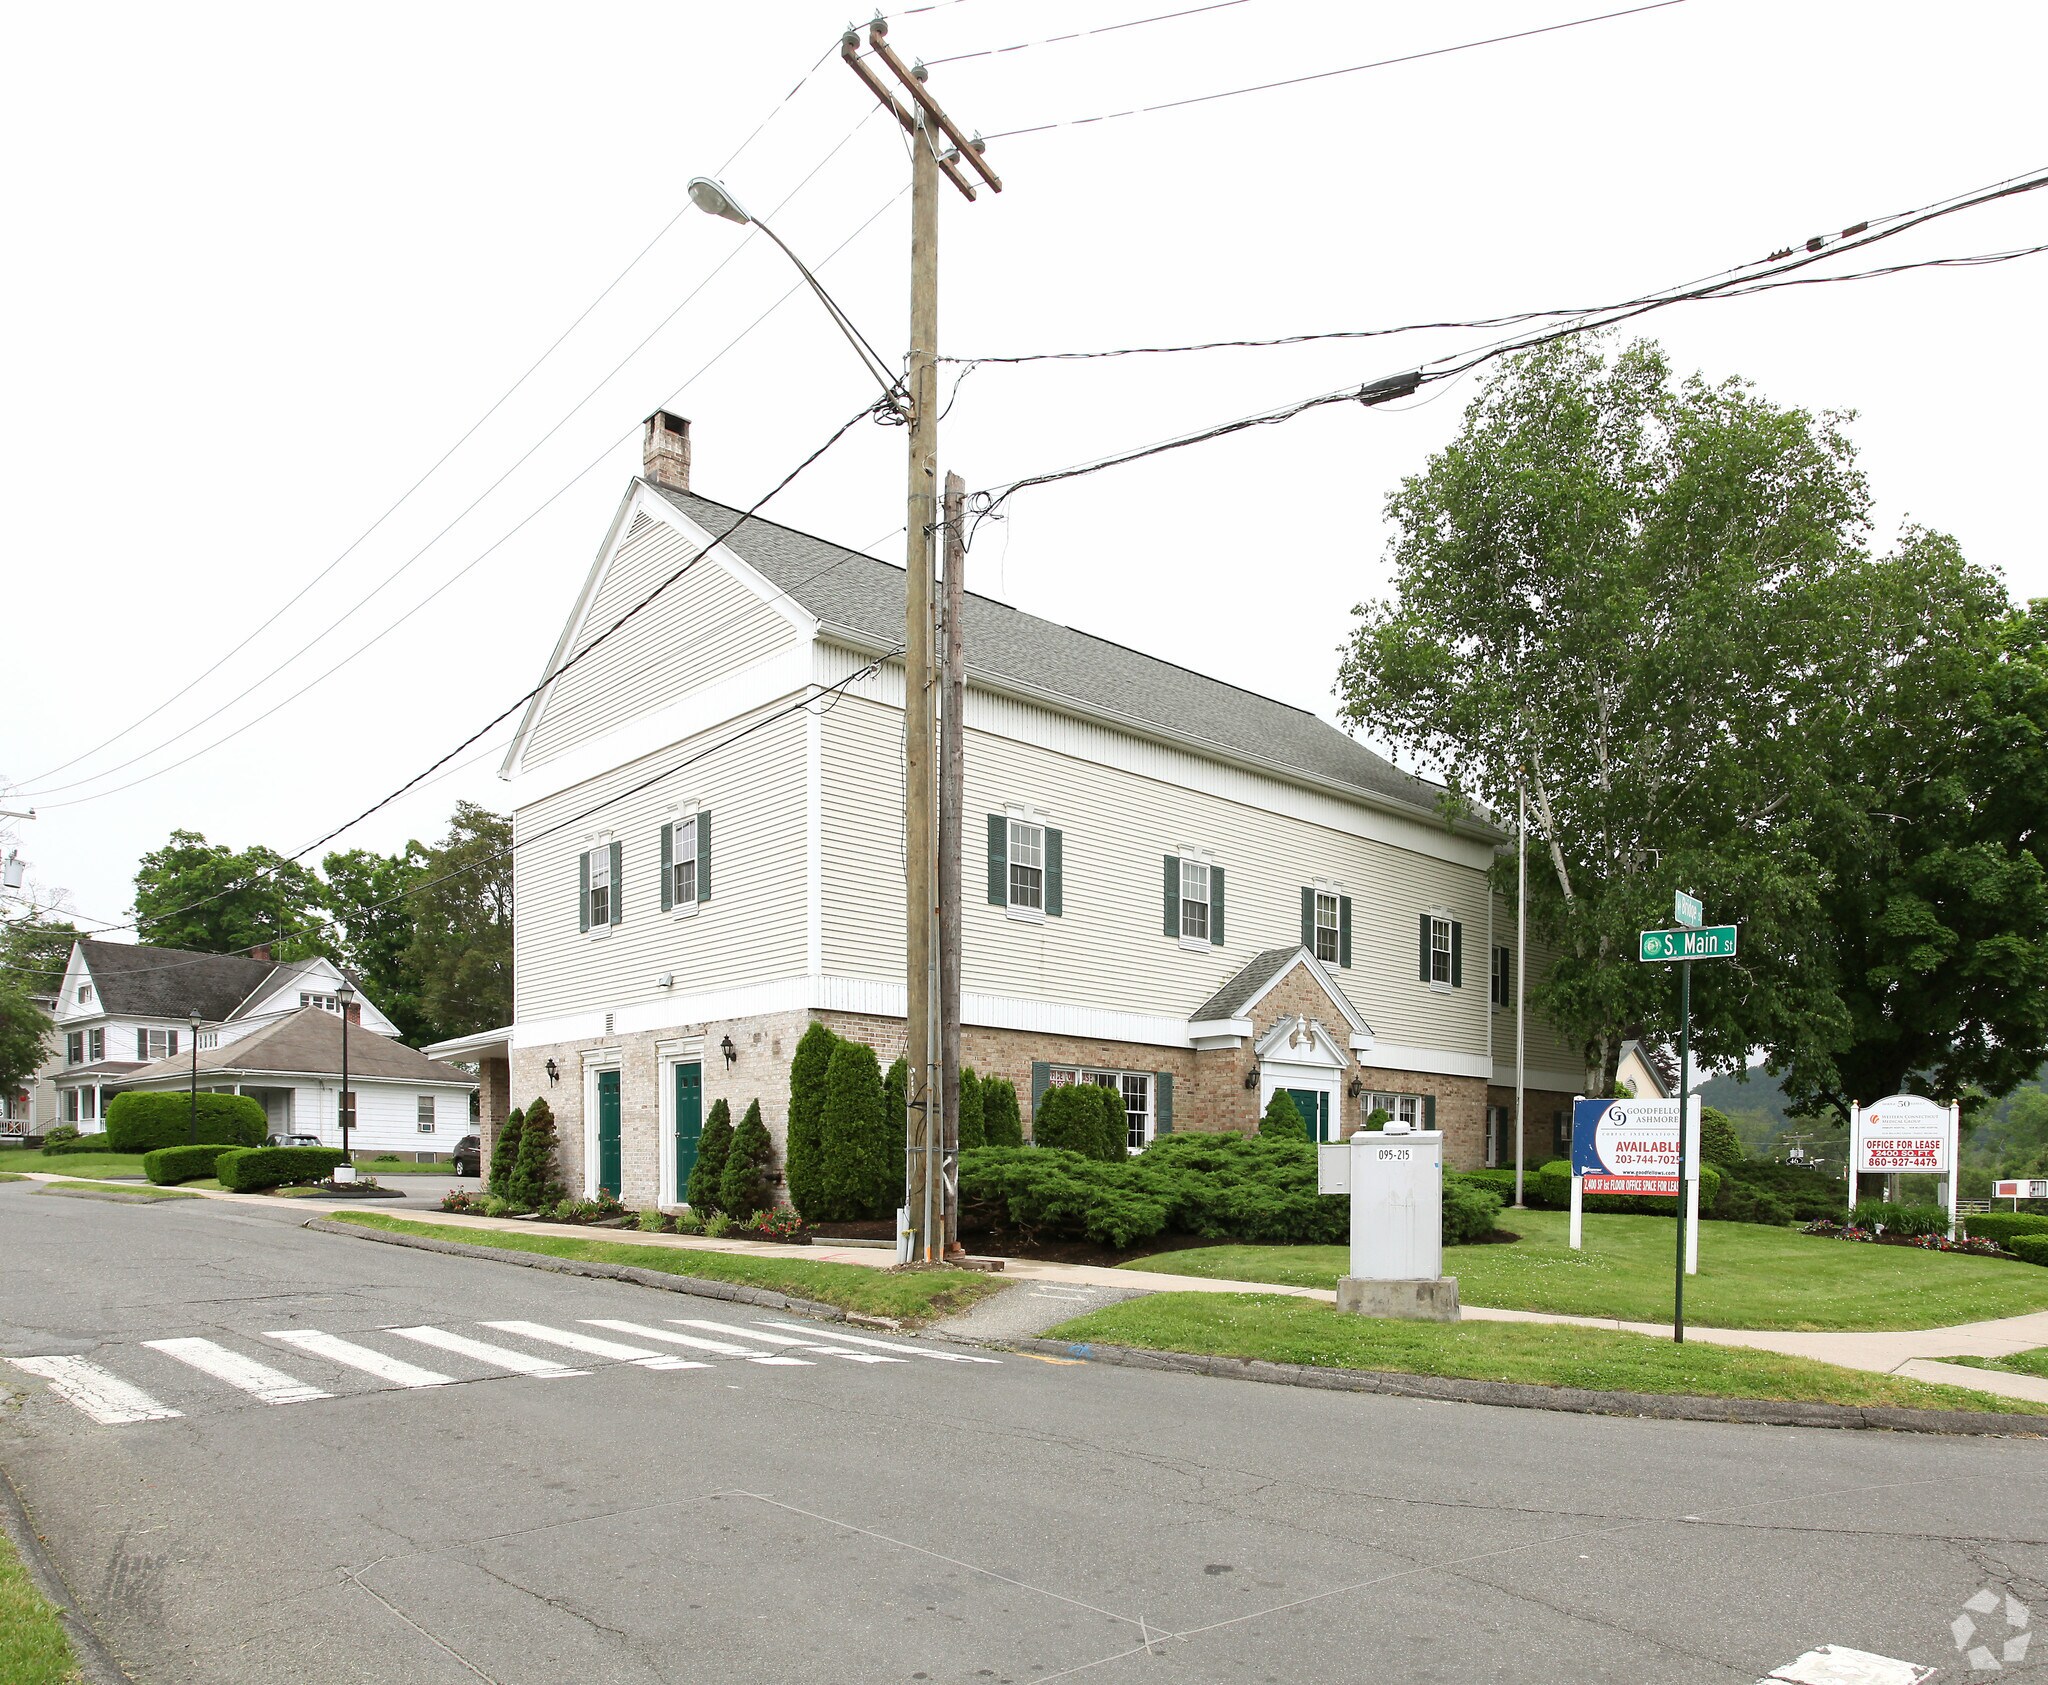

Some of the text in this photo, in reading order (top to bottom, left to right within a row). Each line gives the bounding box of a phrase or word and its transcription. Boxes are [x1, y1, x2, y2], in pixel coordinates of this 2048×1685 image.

[1664, 932, 1733, 955] S. Main St
[1615, 1141, 1680, 1153] AVAILABLE
[1866, 1140, 1940, 1149] OFFICE FOR LEASE
[1379, 1149, 1410, 1160] 095-215
[1615, 1155, 1680, 1165] 203-744-7025
[1868, 1157, 1937, 1167] 860-927-4479
[1597, 1179, 1603, 1190] SF
[1610, 1180, 1625, 1191] FLOOR
[1626, 1180, 1641, 1191] OFFICE
[1642, 1180, 1656, 1191] SPACE
[1657, 1181, 1667, 1192] FOR
[1667, 1181, 1679, 1192] LEAS
